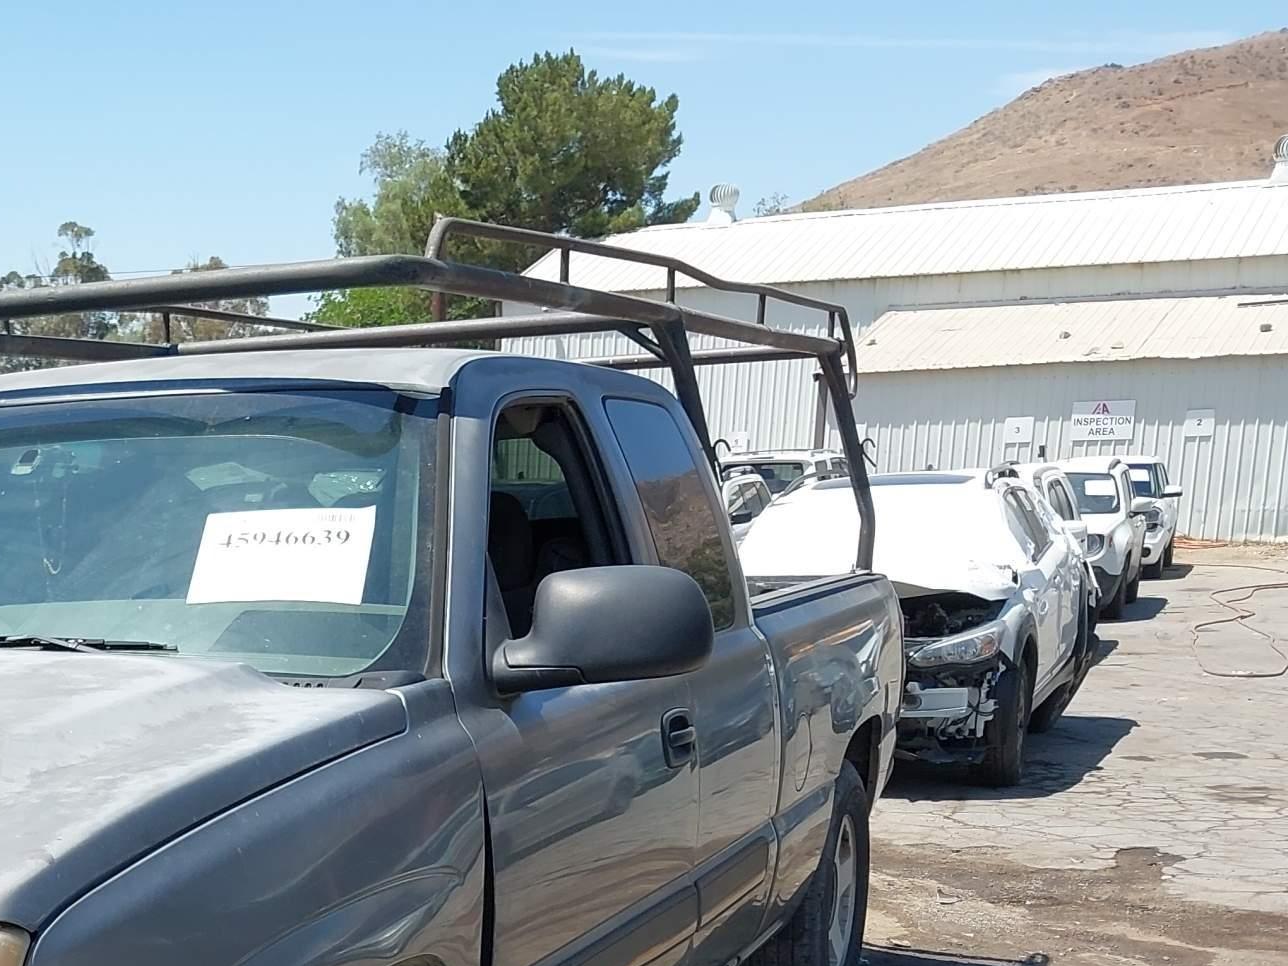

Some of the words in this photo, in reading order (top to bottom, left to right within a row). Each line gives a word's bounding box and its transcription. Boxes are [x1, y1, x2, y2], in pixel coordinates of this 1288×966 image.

[1073, 416, 1132, 426] INSPECTION
[1196, 418, 1202, 426] 2
[1015, 426, 1020, 434] 3
[1088, 427, 1115, 436] AREA
[220, 529, 351, 548] 45946639
